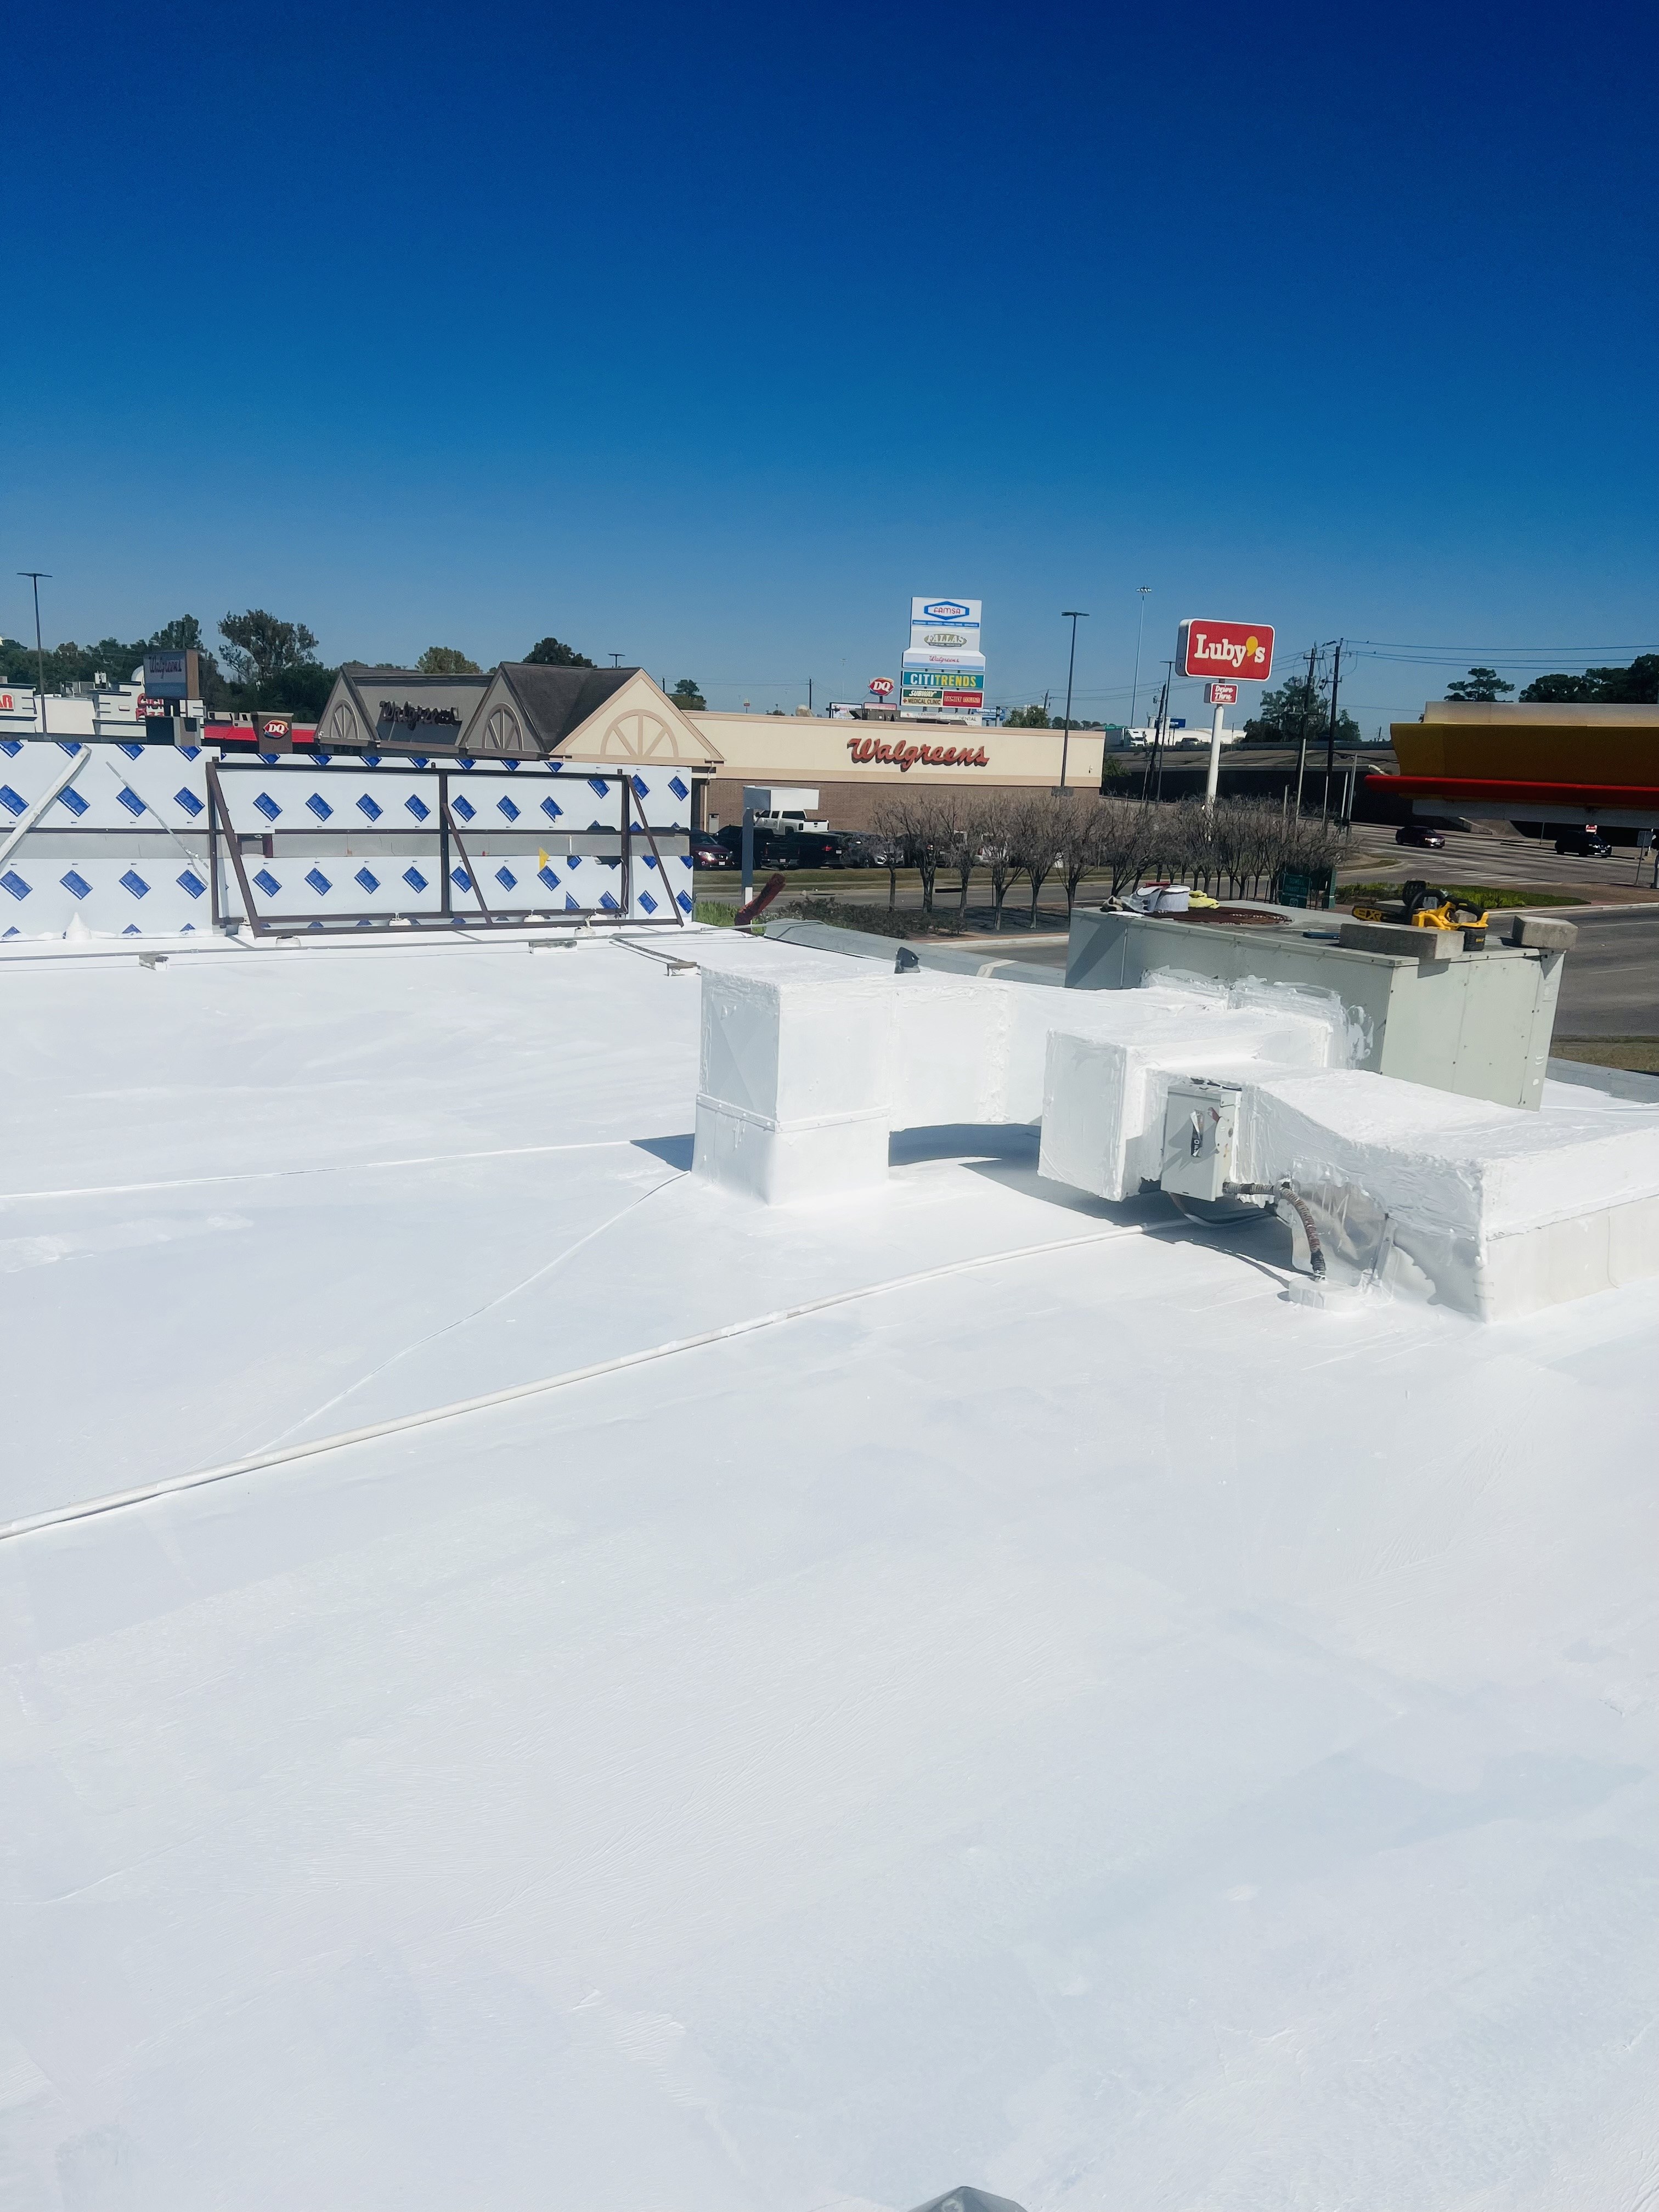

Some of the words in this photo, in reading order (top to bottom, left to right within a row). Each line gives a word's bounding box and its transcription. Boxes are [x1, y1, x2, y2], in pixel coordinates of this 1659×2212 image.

[927, 634, 964, 644] FALLAS
[1194, 634, 1266, 668] Luby's
[149, 656, 182, 679] Walgreens
[873, 681, 891, 692] DQ
[268, 724, 285, 735] DQ
[847, 738, 990, 772] Walgreens
